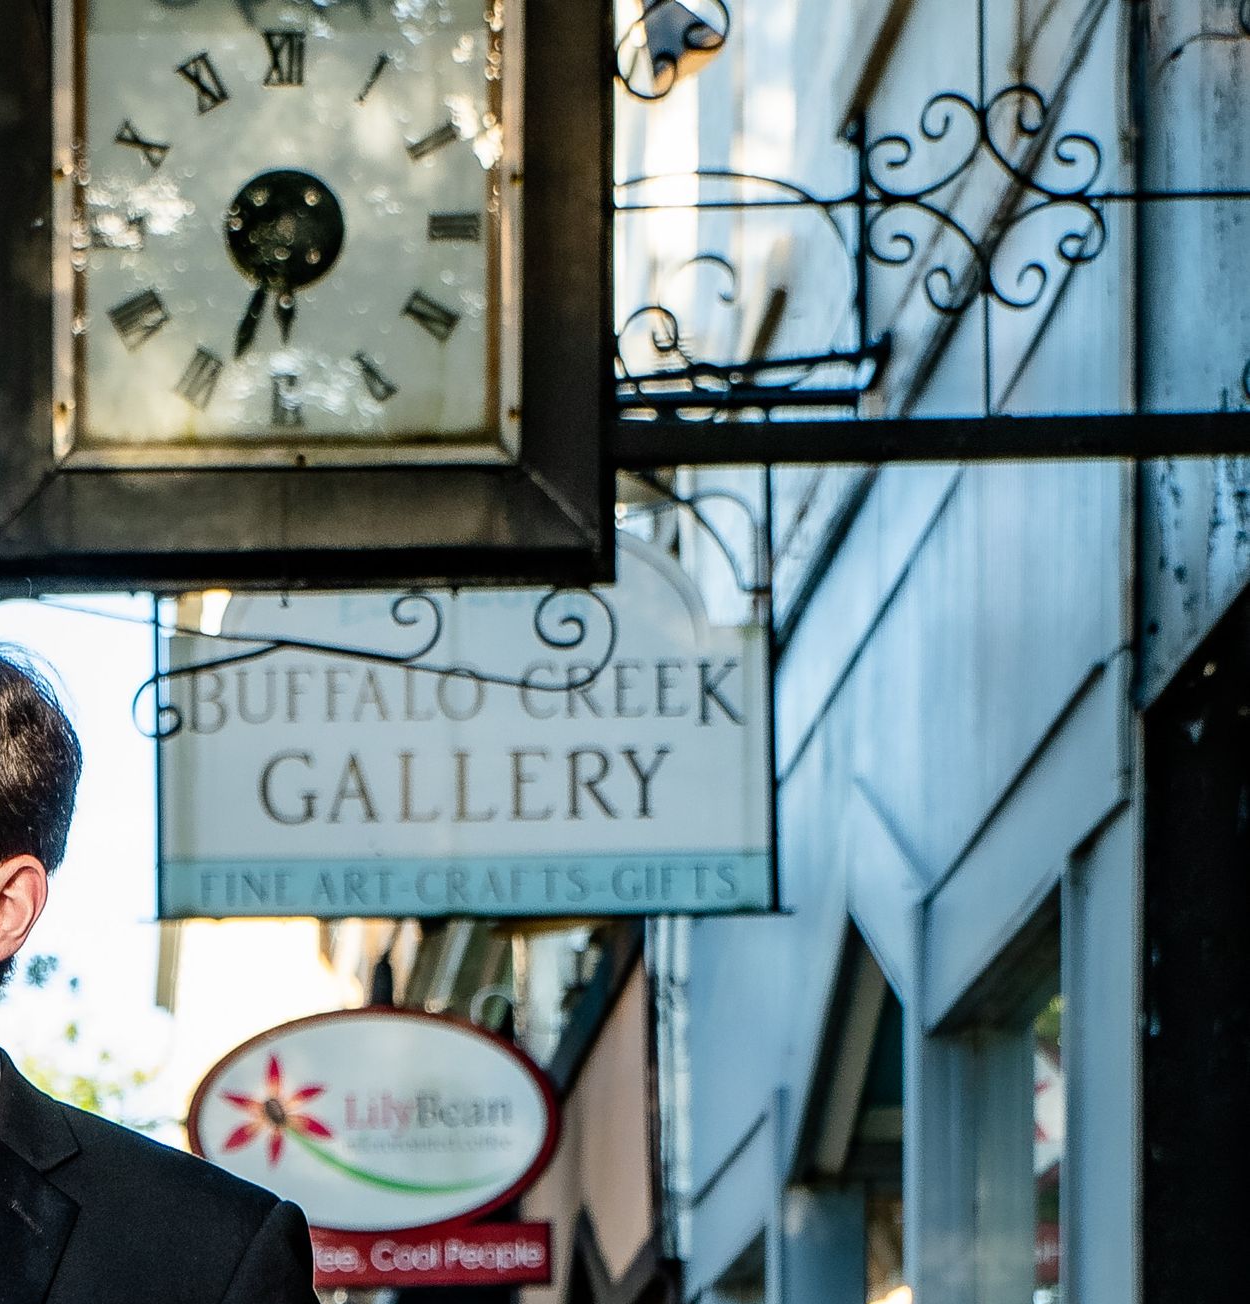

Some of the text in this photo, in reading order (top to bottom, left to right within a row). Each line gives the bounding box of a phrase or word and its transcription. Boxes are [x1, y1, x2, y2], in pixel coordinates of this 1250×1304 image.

[176, 52, 229, 115] XI
[262, 29, 306, 88] XII
[356, 54, 389, 103] I
[114, 117, 172, 170] X
[427, 212, 482, 242] III
[352, 352, 398, 402] V
[187, 655, 748, 735] BUFFALO CREEK
[258, 748, 671, 826] GALLERY
[199, 865, 293, 906] FINE
[371, 1239, 442, 1272] Cool
[445, 1238, 546, 1272] People
